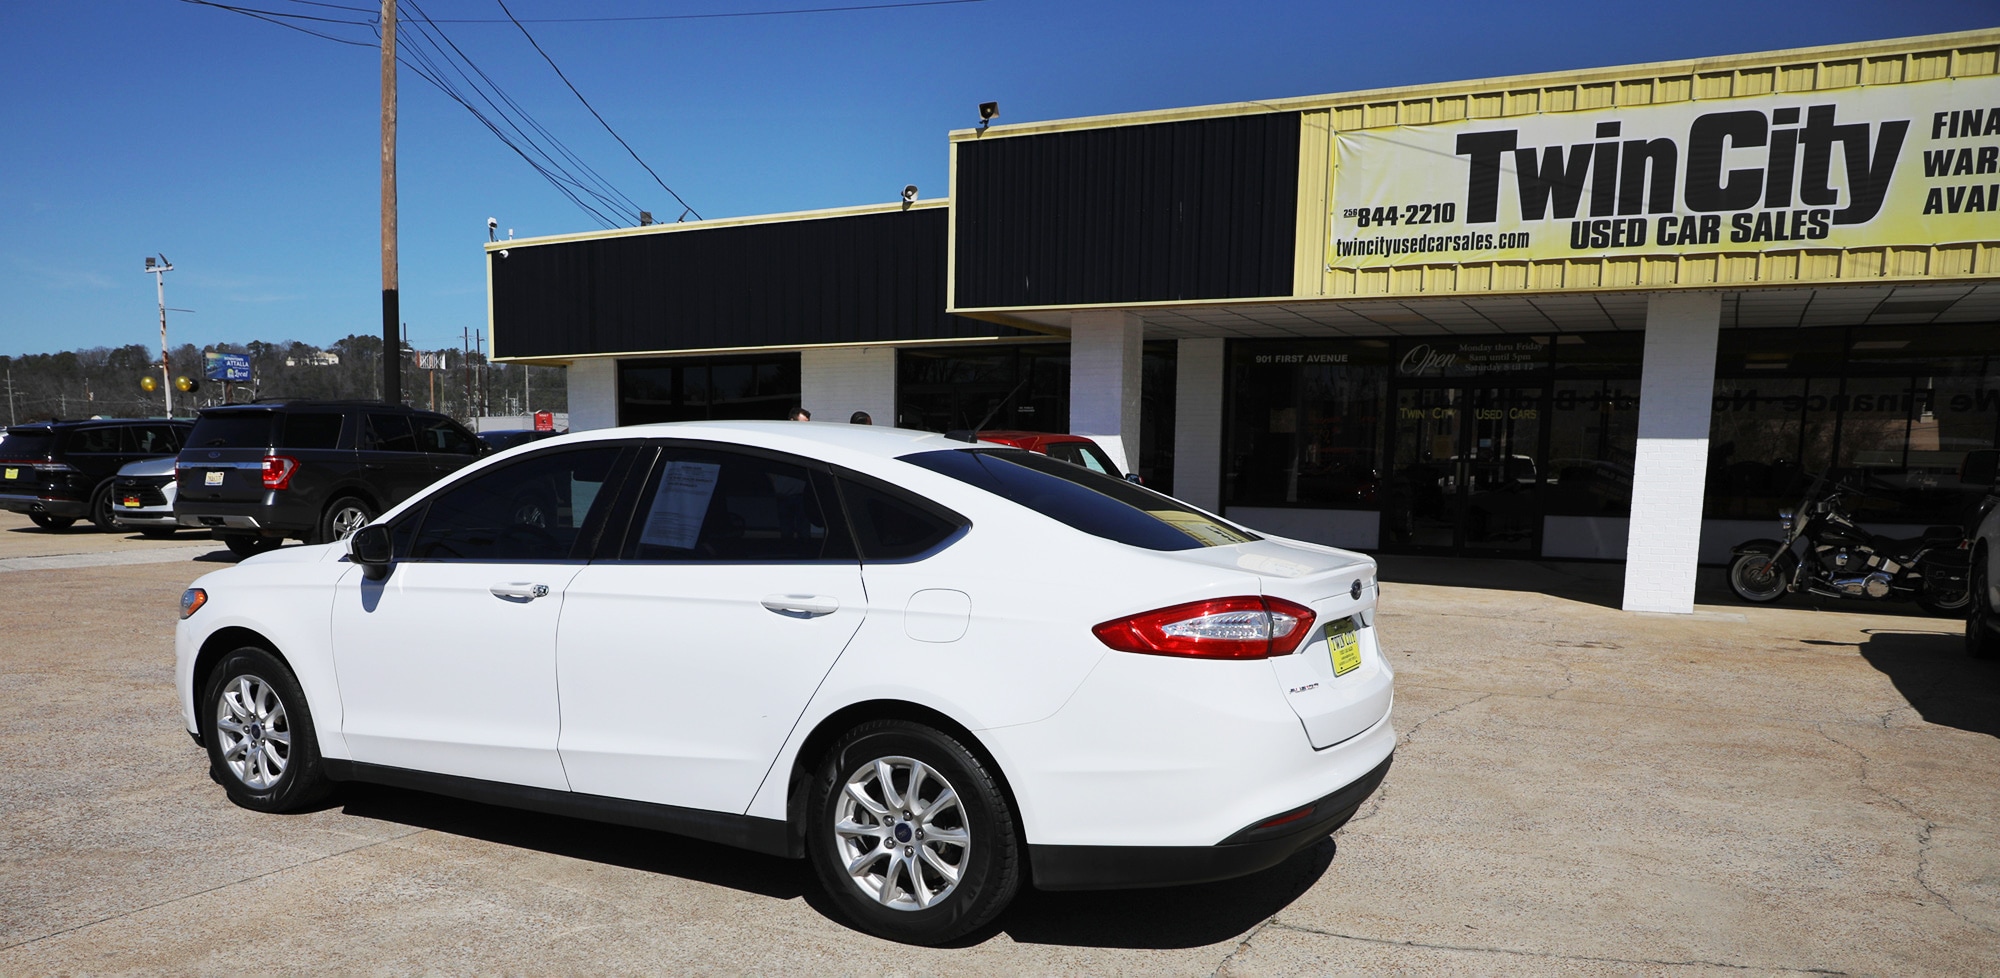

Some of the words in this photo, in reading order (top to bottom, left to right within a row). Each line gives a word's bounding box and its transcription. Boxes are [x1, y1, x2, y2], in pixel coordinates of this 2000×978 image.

[1931, 107, 2000, 140] FINA
[1357, 202, 1455, 228] 844-2210
[1570, 217, 1648, 249] USED
[1656, 214, 1721, 247] CAR
[1730, 208, 1831, 243] SALES
[1336, 229, 1530, 258] twincityusedcarsales.com
[1458, 343, 1493, 353] Monday
[1494, 343, 1513, 352] thru
[1515, 341, 1544, 352] Friday
[1255, 354, 1272, 363] 901
[1275, 354, 1304, 363] FIRST
[1306, 353, 1348, 363] AVENUE
[1400, 343, 1457, 375] Open
[1465, 362, 1500, 373] Saturday
[1523, 361, 1535, 371] 12
[1489, 352, 1510, 362] until
[1512, 352, 1531, 363] 5pm
[1400, 408, 1425, 419] TWIN
[1475, 408, 1503, 420] USED
[1508, 407, 1537, 420] CARS
